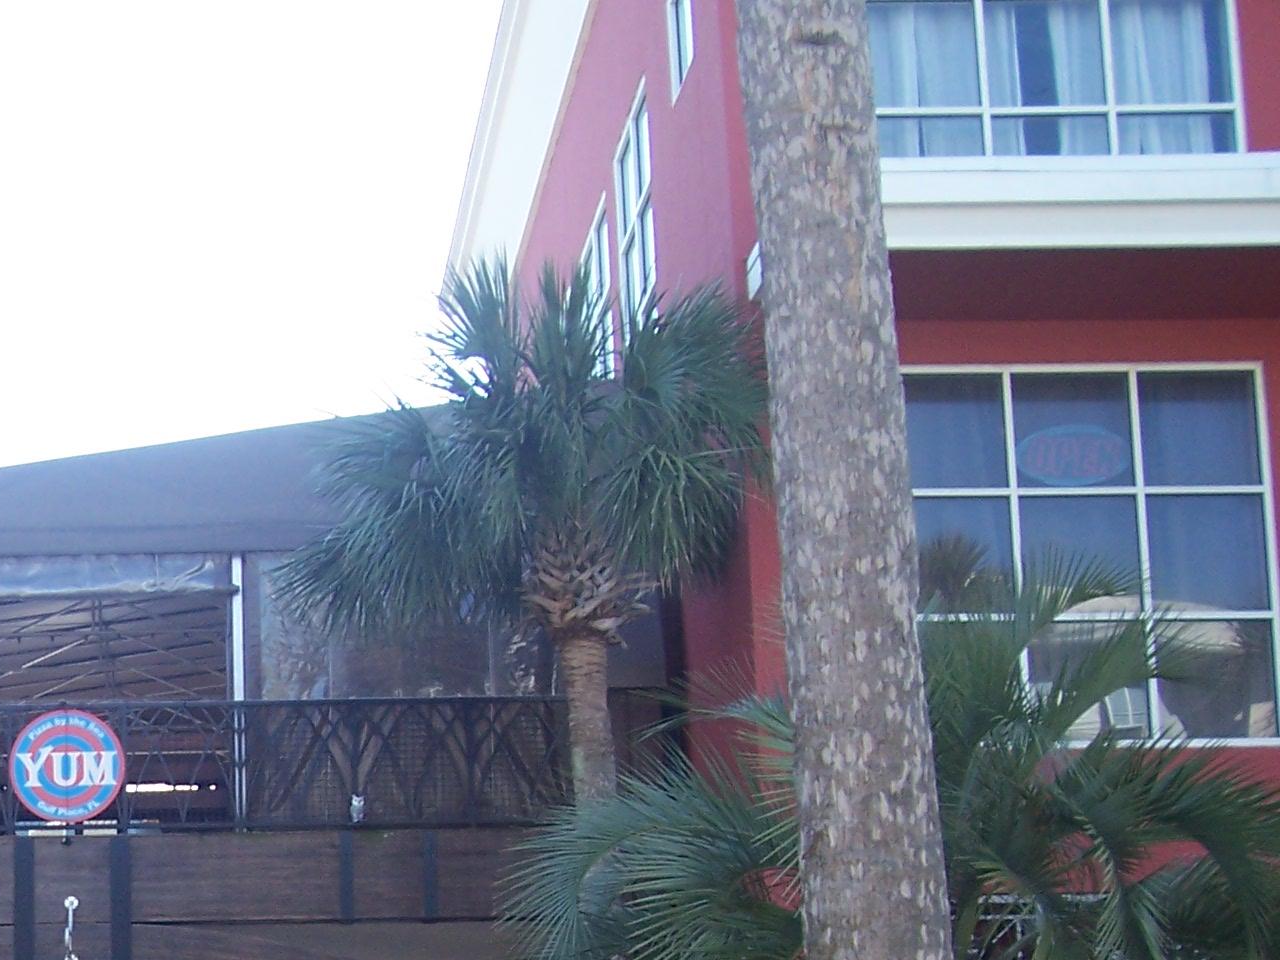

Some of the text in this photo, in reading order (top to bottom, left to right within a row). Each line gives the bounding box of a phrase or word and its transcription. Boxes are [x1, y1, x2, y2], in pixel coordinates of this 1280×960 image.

[54, 717, 66, 726] by
[68, 717, 87, 727] the
[16, 744, 117, 788] YUM
